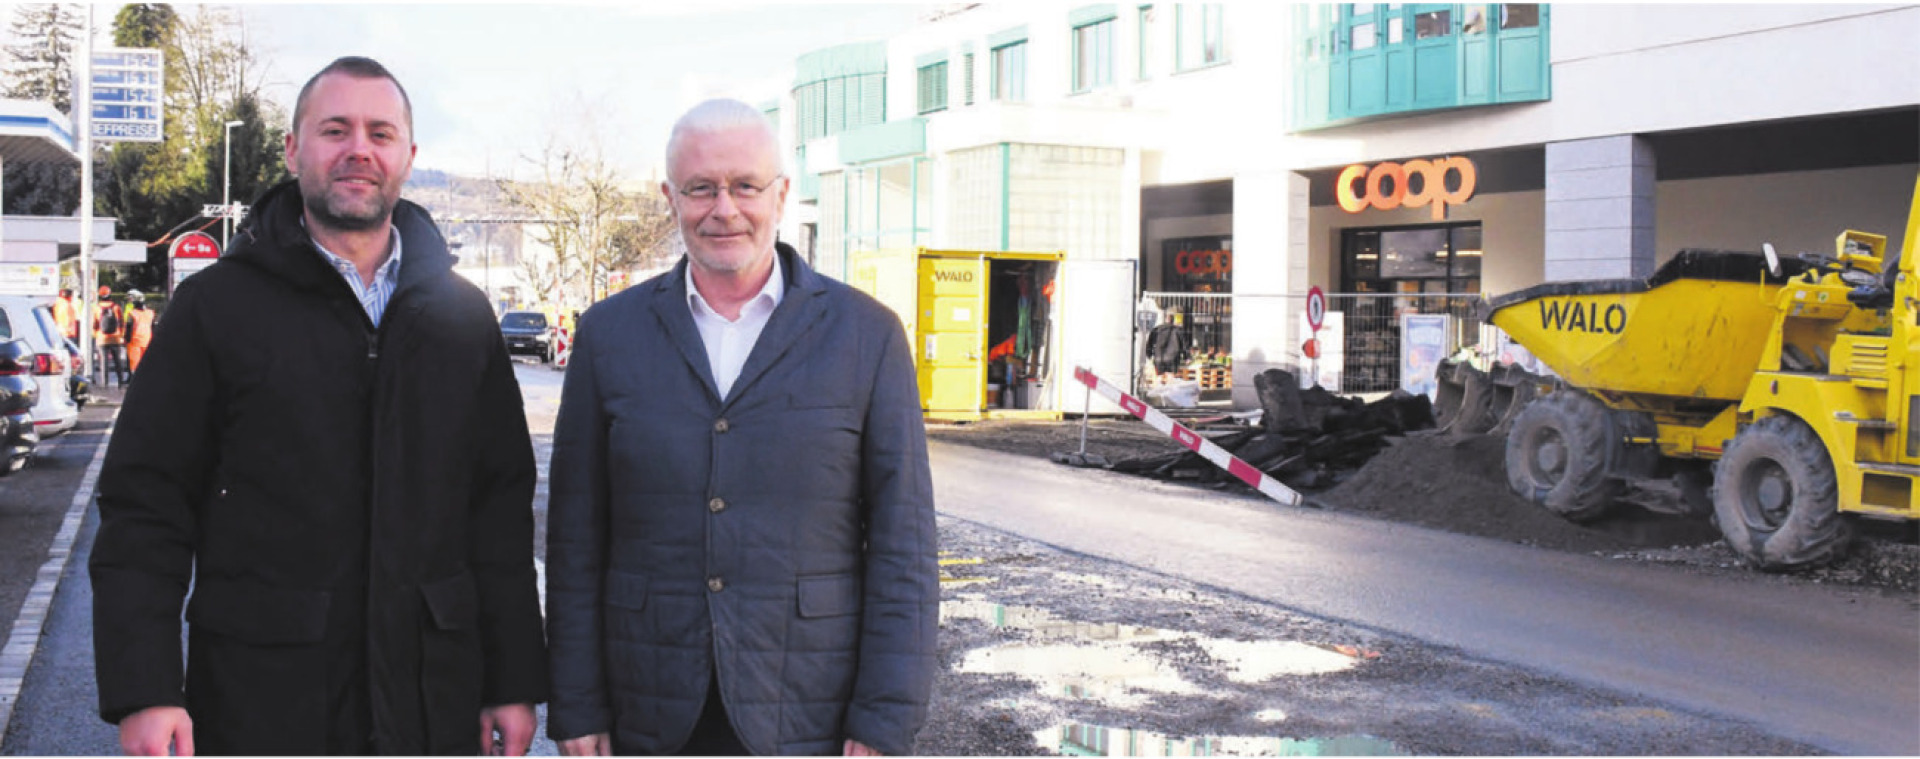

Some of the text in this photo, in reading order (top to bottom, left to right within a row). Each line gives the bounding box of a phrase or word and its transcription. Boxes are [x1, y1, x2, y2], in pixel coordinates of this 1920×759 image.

[1336, 156, 1476, 221] coop
[935, 270, 973, 283] WALO
[1175, 250, 1233, 280] coop
[1540, 300, 1627, 335] WALO
